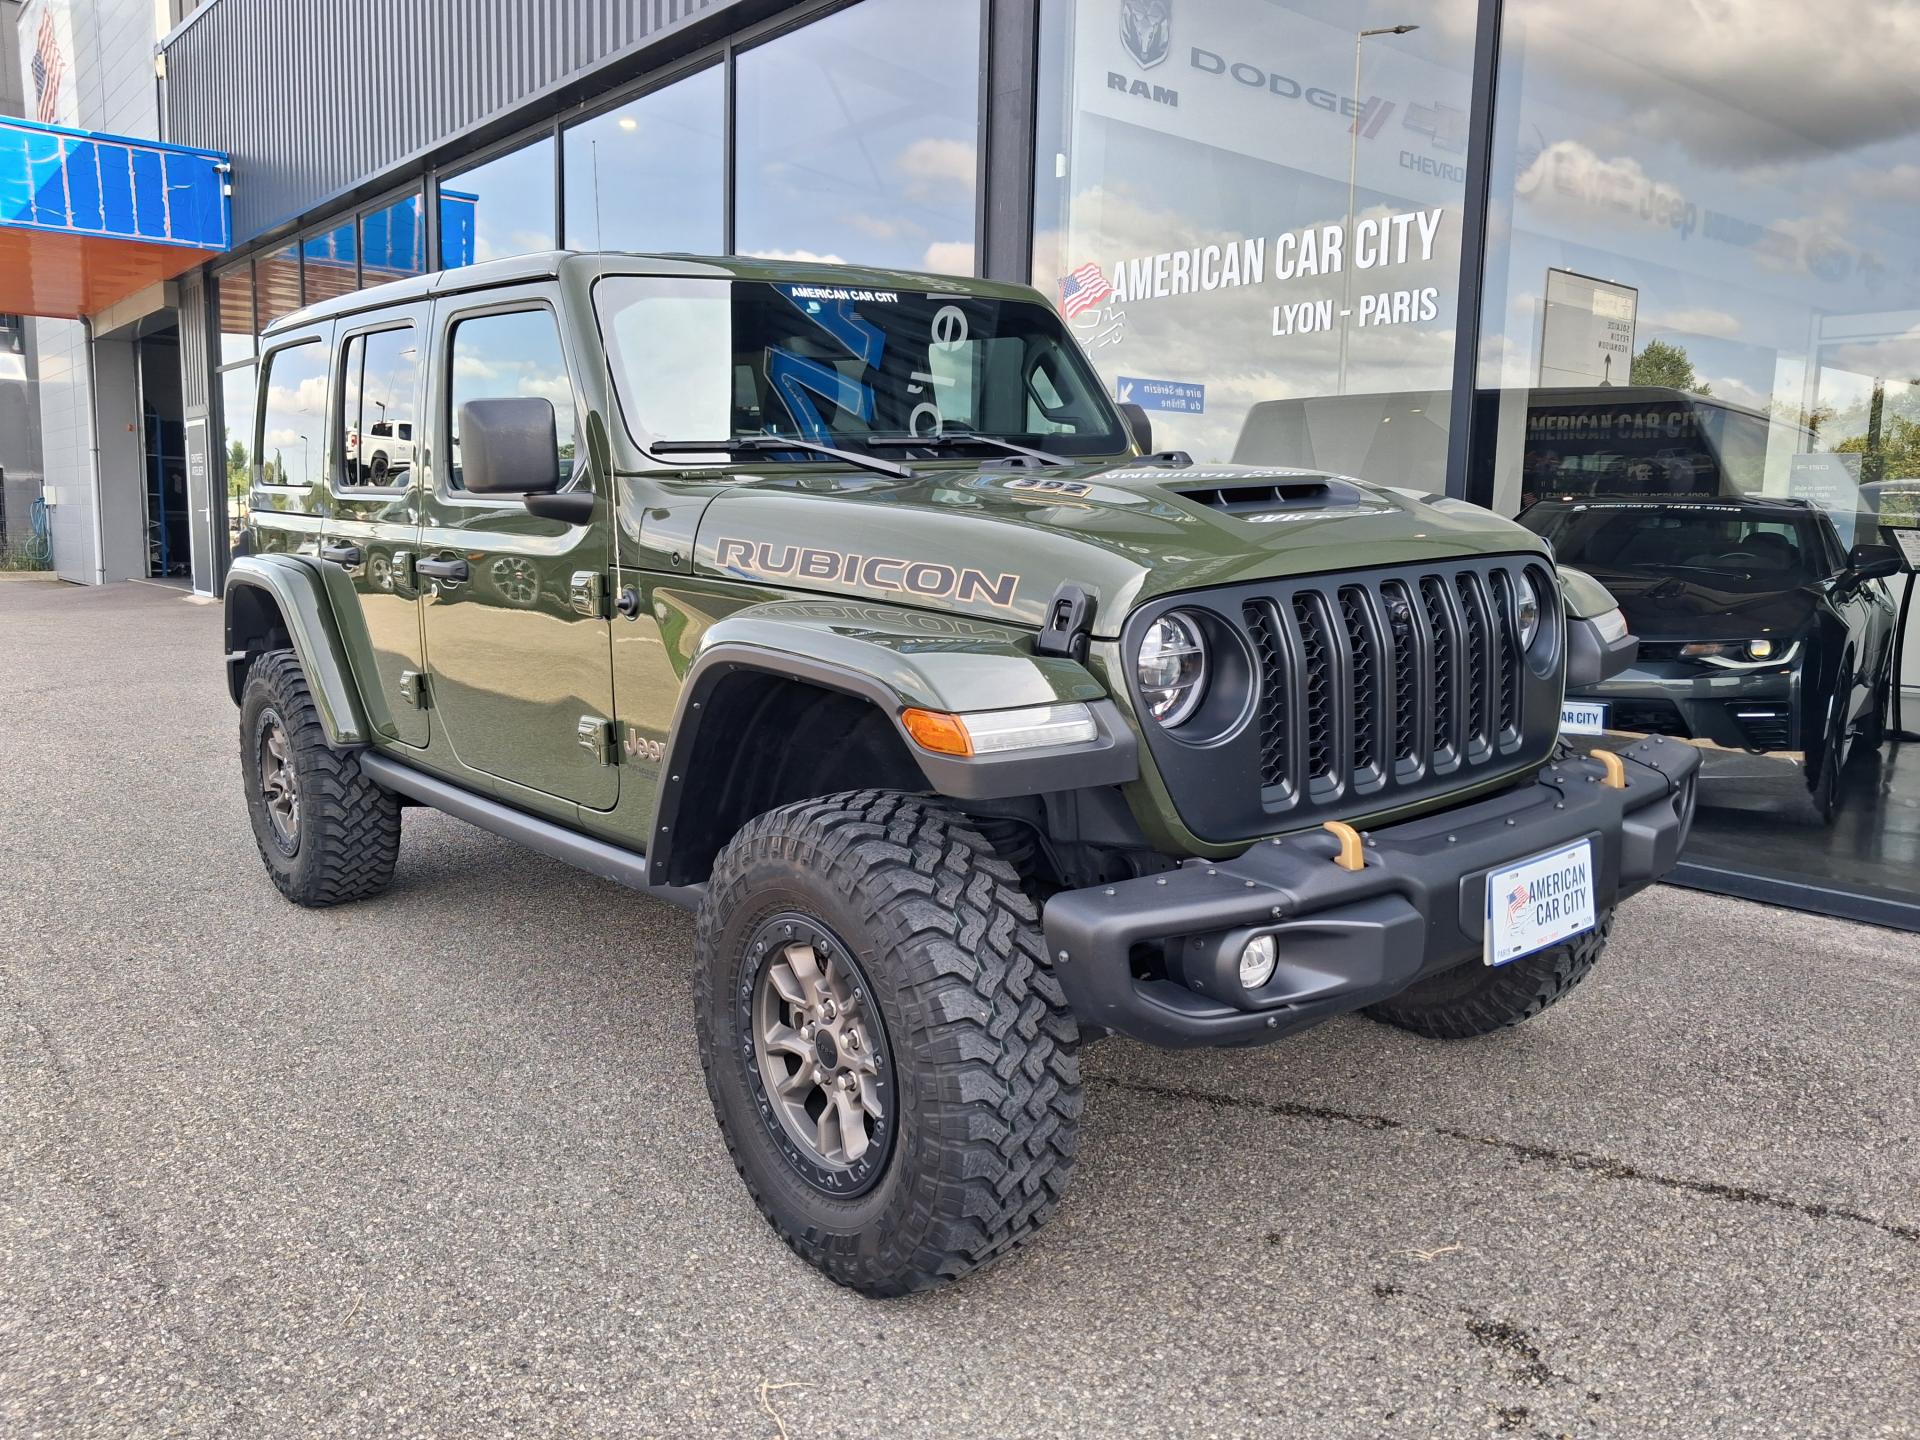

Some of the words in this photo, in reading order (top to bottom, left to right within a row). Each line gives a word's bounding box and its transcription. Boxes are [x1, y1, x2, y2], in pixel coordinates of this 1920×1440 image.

[1107, 71, 1178, 107] RAM
[1190, 46, 1367, 118] DODGE
[1110, 237, 1266, 304] AMERICAN
[1275, 225, 1343, 280] CAR
[1355, 208, 1442, 269] CITY
[791, 286, 850, 301] AMERICAN
[850, 290, 875, 303] CAR
[876, 292, 899, 303] CITY
[1272, 299, 1332, 336] LYON
[1358, 287, 1438, 328] PARIS
[1617, 412, 1660, 441] CAR
[714, 536, 1020, 609] RUBICON
[1576, 712, 1599, 725] CITY
[1528, 862, 1586, 904] AMERICAN
[1536, 898, 1560, 926] CAR
[1563, 887, 1587, 916] CITY
